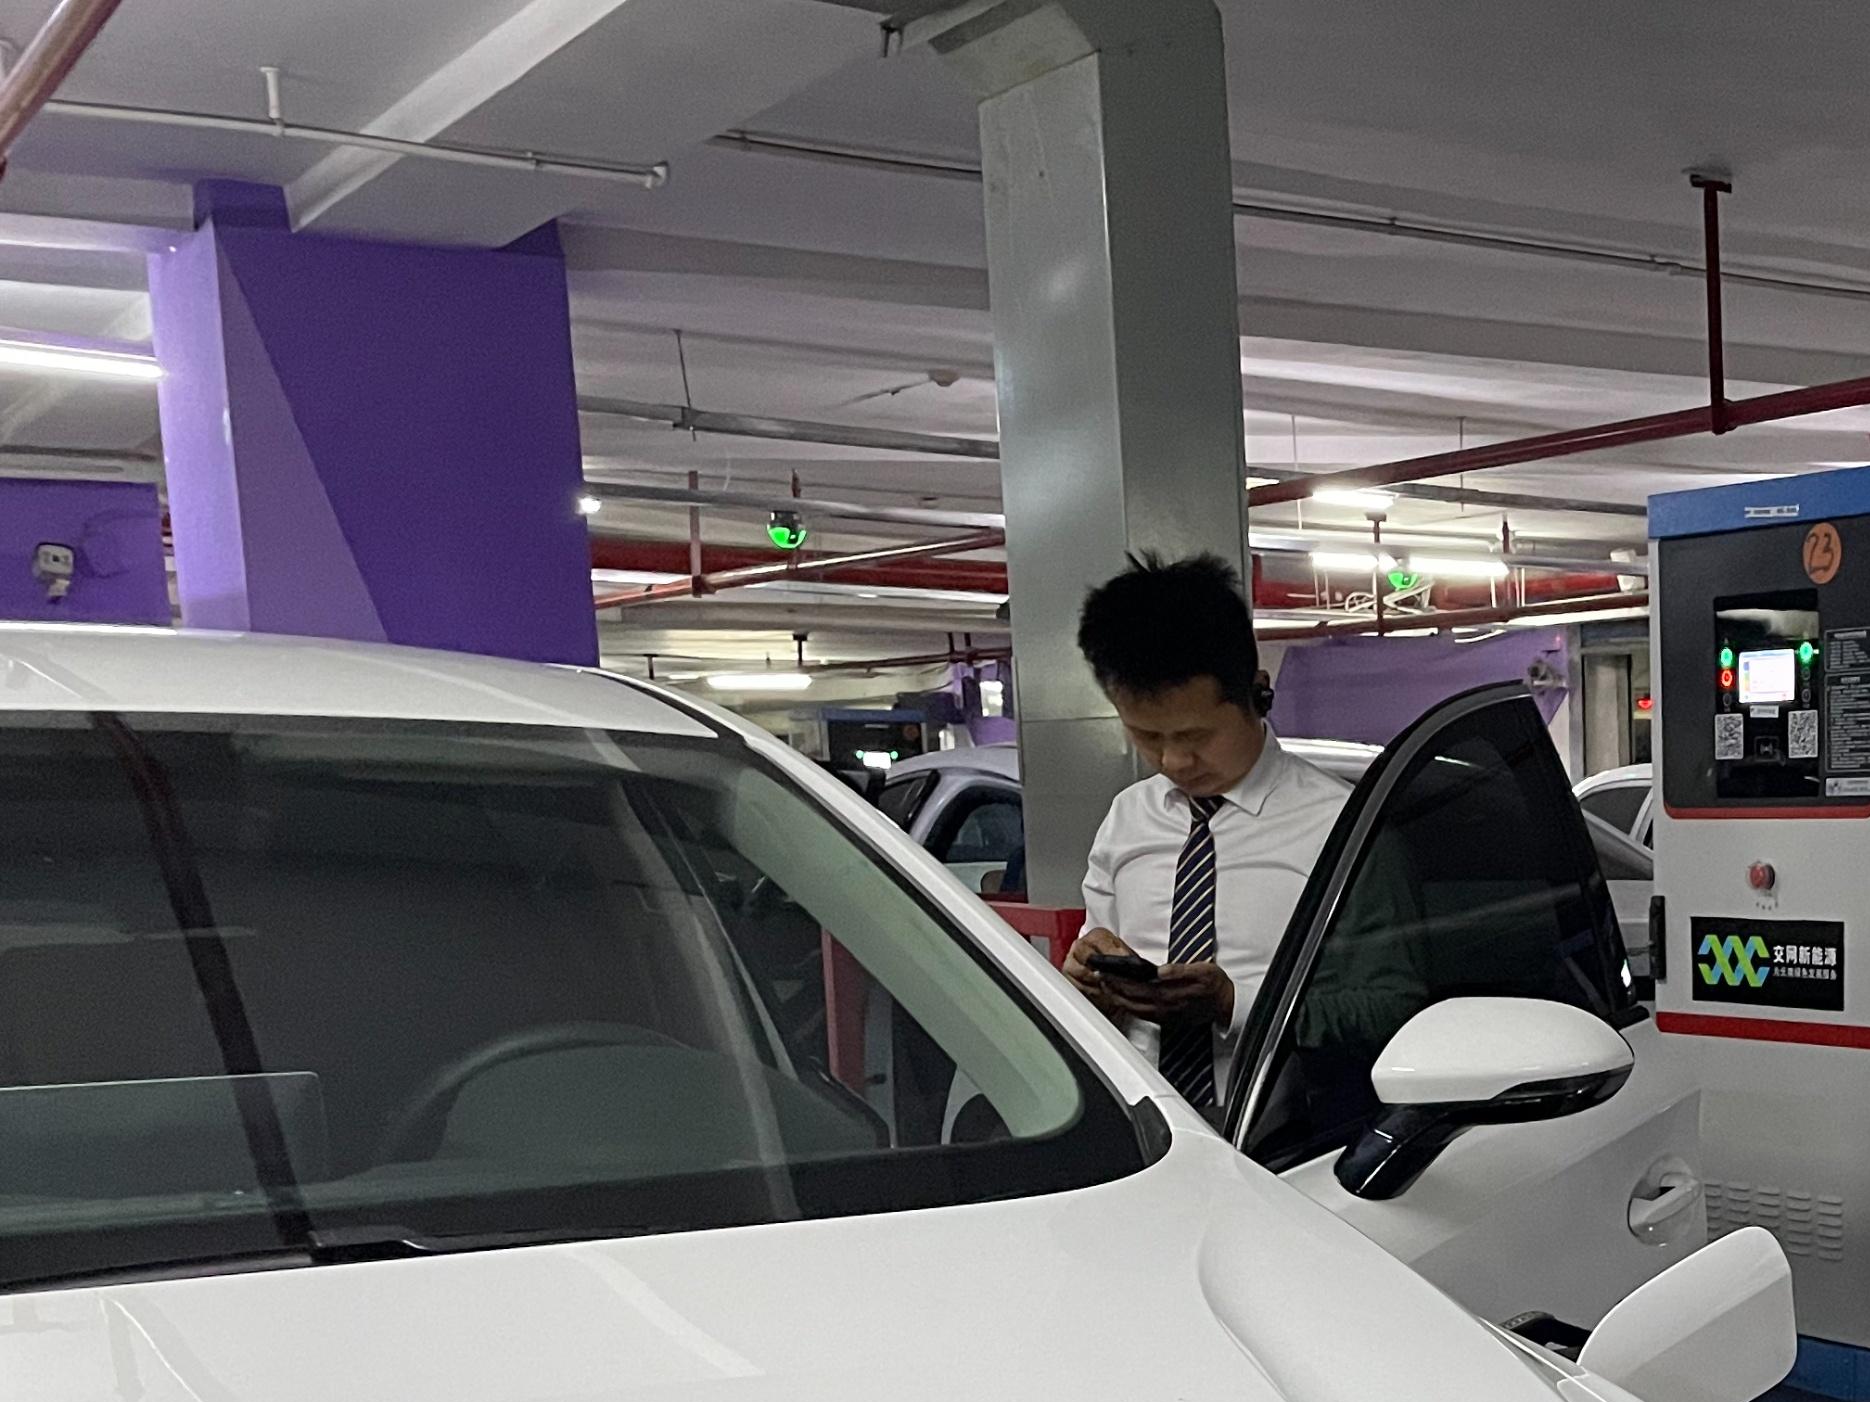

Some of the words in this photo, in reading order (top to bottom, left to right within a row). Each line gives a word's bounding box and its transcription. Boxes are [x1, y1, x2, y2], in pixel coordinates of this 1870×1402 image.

[1807, 532, 1835, 575] 23
[1773, 944, 1837, 967] 交网新能源
